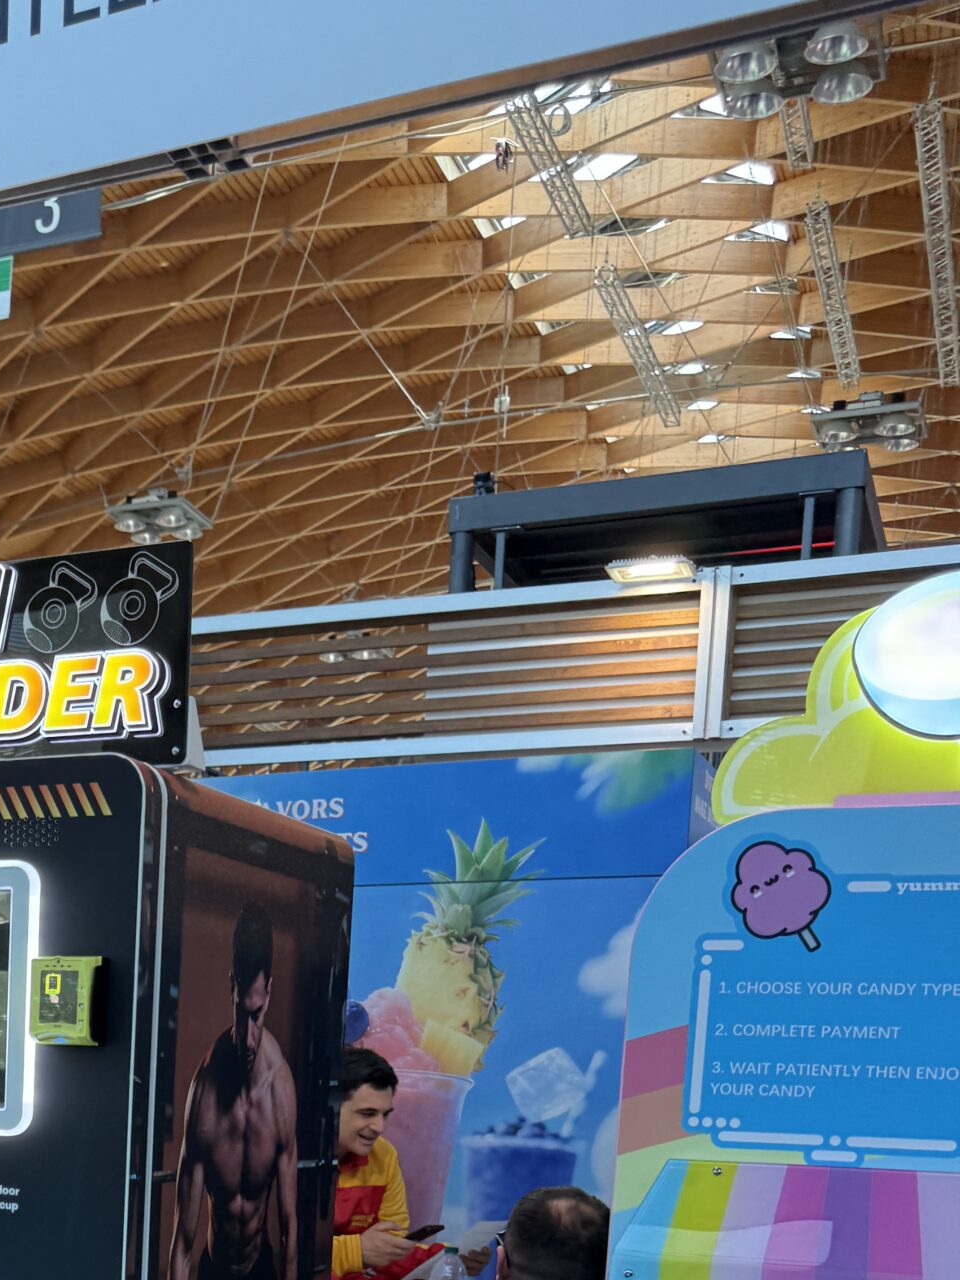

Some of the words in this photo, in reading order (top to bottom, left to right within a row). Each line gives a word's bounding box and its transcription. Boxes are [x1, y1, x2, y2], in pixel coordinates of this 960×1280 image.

[718, 981, 732, 994] 1.
[736, 981, 802, 995] CHOOSE
[806, 982, 852, 995] YOUR
[857, 983, 916, 996] CANDY
[922, 983, 960, 997] TYPE
[714, 1024, 728, 1037] 2.
[732, 1024, 816, 1038] COMPLETE
[821, 1025, 901, 1039] PAYMENT
[711, 1061, 725, 1074] 3.
[729, 1062, 772, 1075] WAIT
[775, 1063, 861, 1078] PATIENTLY
[866, 1065, 910, 1080] THEN
[710, 1083, 754, 1096] YOUR
[758, 1084, 816, 1099] CANDY
[0, 1201, 19, 1213] cup
